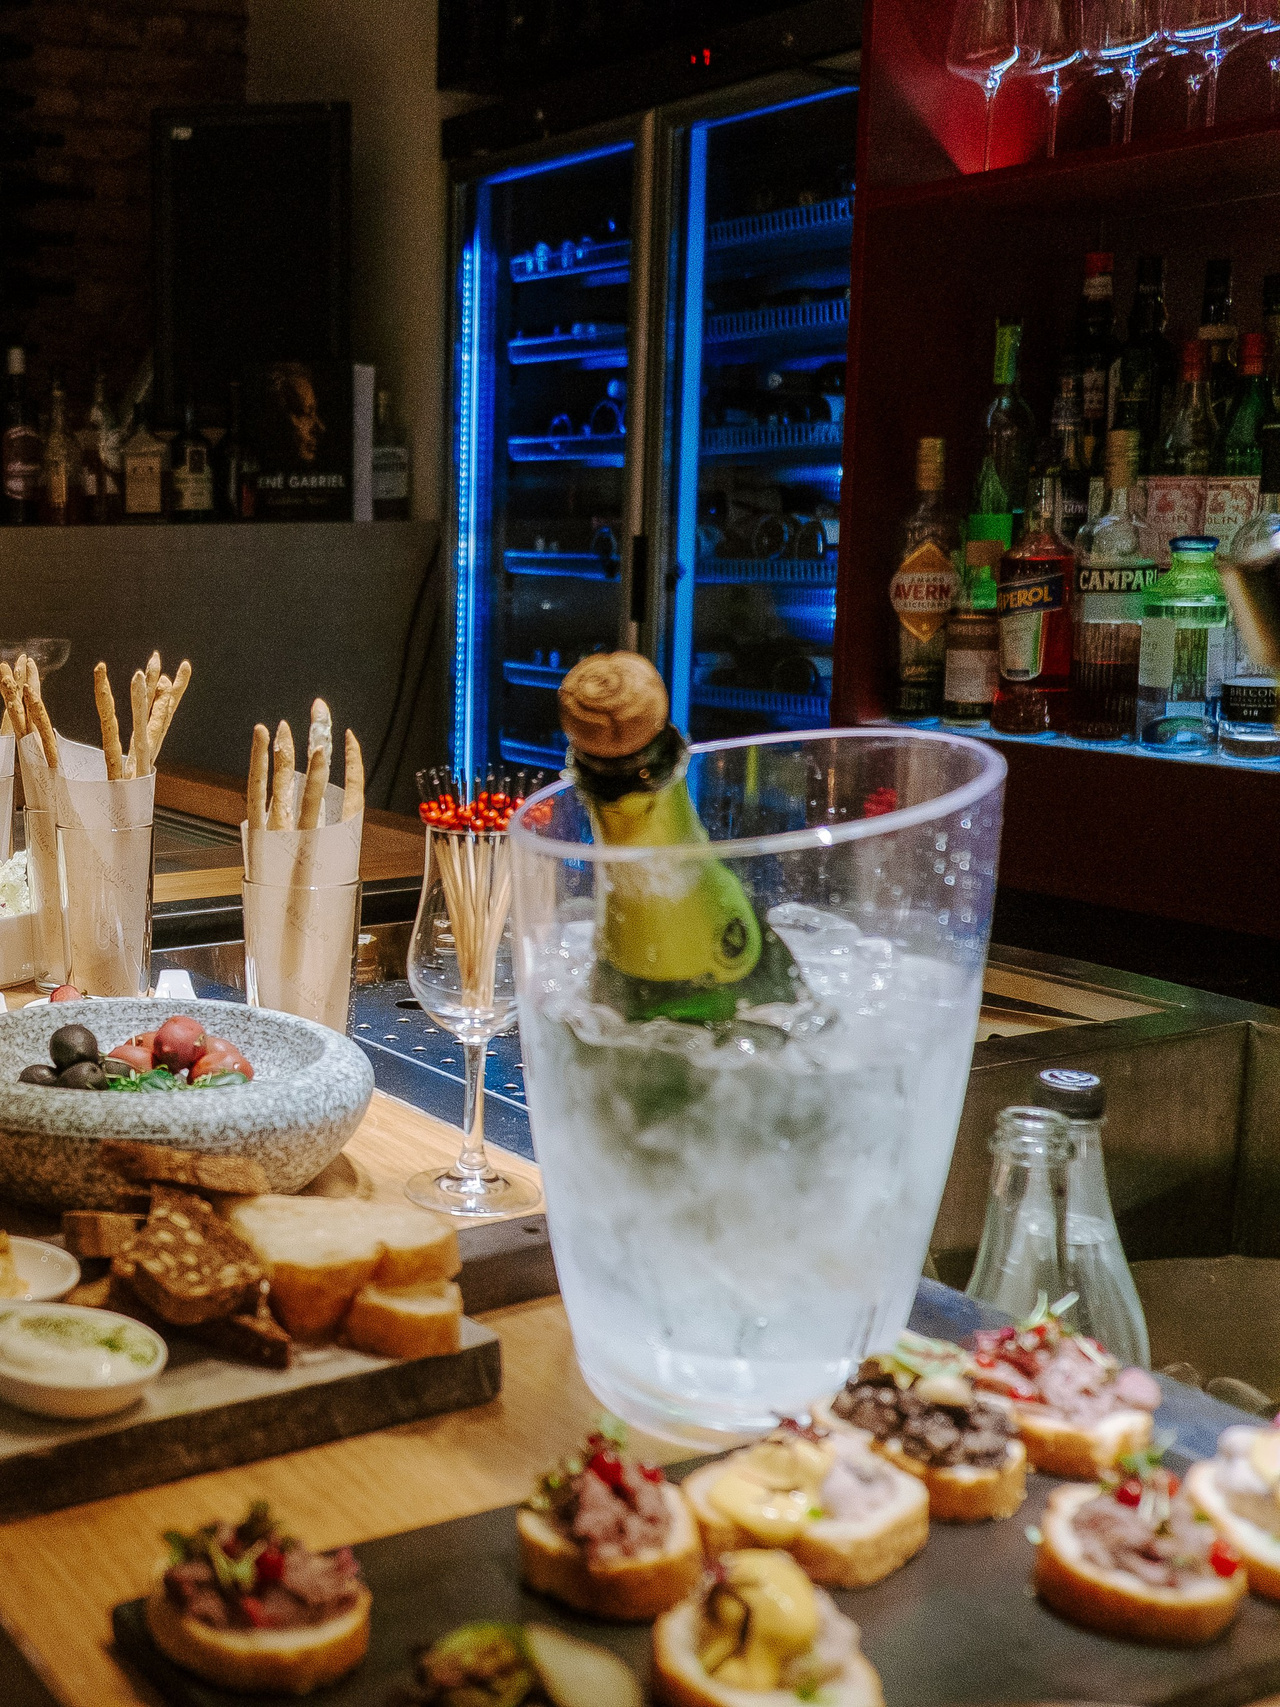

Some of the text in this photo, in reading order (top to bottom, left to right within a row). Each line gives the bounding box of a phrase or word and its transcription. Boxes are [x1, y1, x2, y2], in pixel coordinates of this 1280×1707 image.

[256, 472, 346, 489] ENÉ GABRIEL
[1079, 568, 1158, 591] CAMPARI
